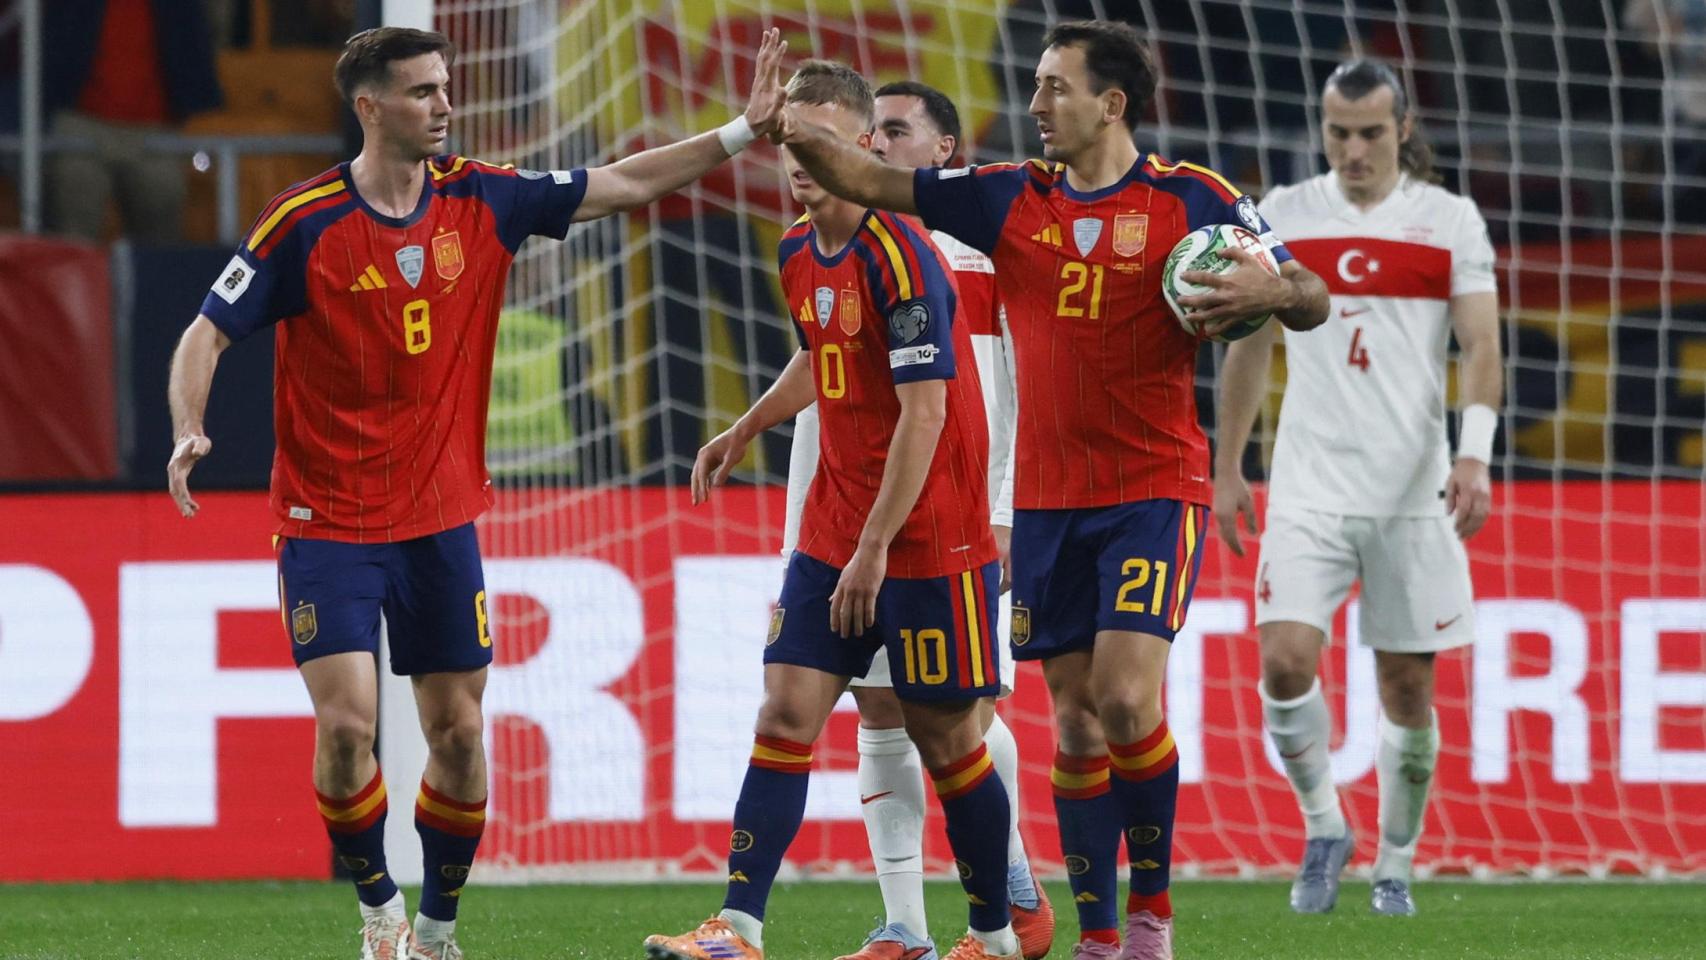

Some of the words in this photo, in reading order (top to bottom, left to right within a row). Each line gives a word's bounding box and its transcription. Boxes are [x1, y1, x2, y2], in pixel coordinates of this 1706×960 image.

[1058, 261, 1103, 318] 21
[403, 299, 431, 355] 8
[1348, 326, 1369, 371] 4
[1115, 558, 1168, 616] 21
[1257, 561, 1272, 604] 4
[900, 628, 948, 684] 10
